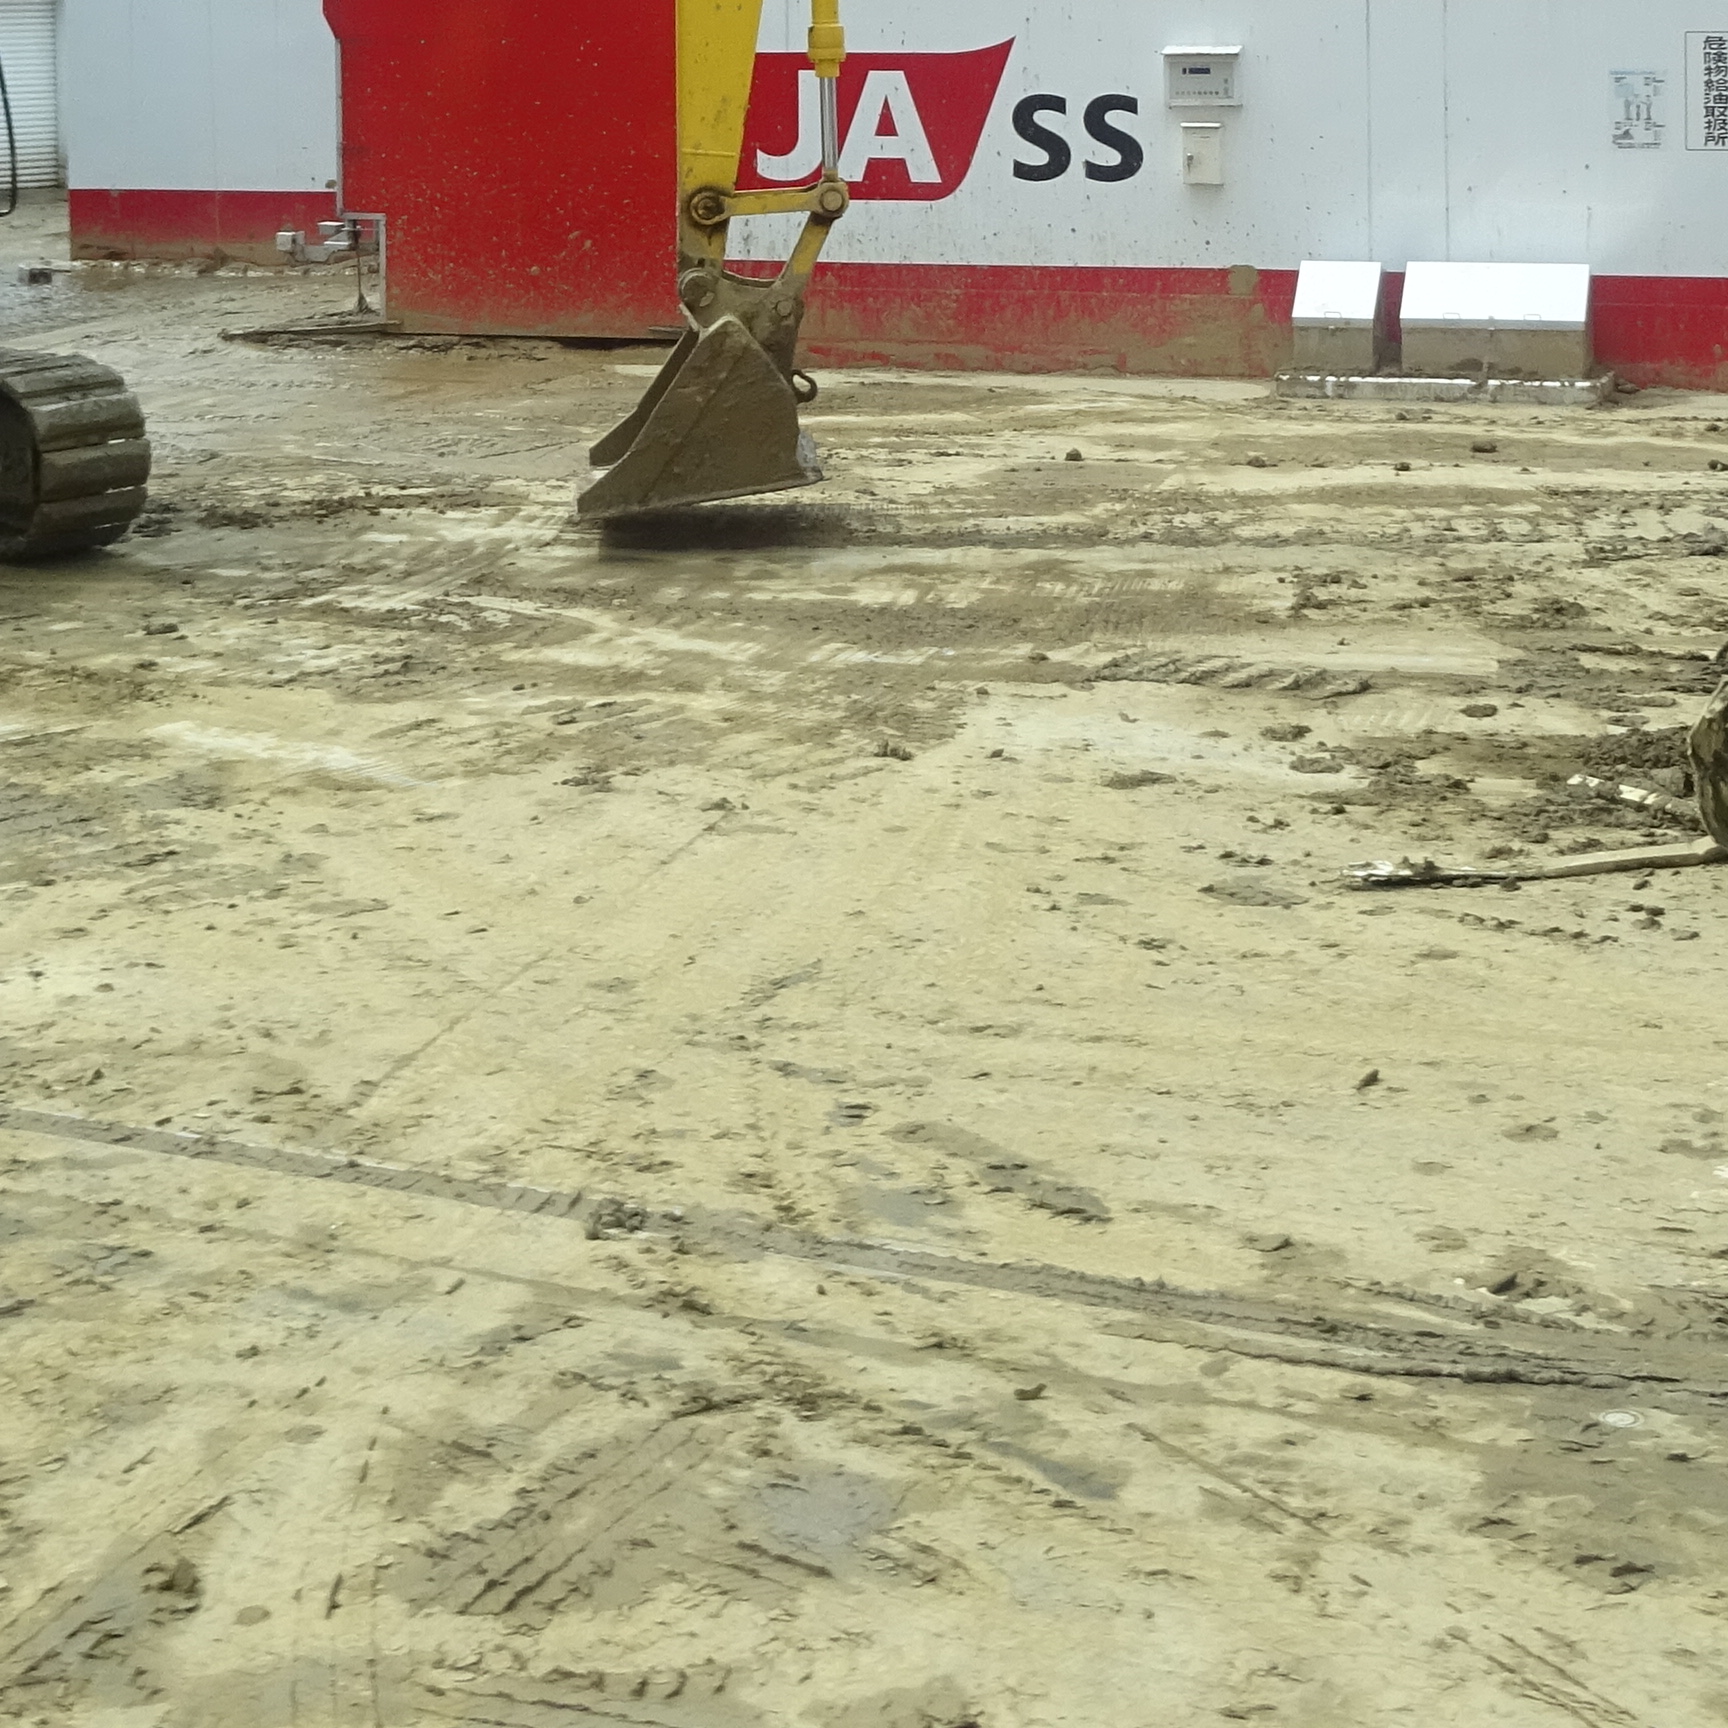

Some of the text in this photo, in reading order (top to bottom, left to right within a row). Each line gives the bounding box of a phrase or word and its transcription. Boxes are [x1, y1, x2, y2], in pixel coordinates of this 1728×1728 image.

[756, 69, 1144, 183] JA SS
[1702, 36, 1728, 147] 危険物給油取扱所
